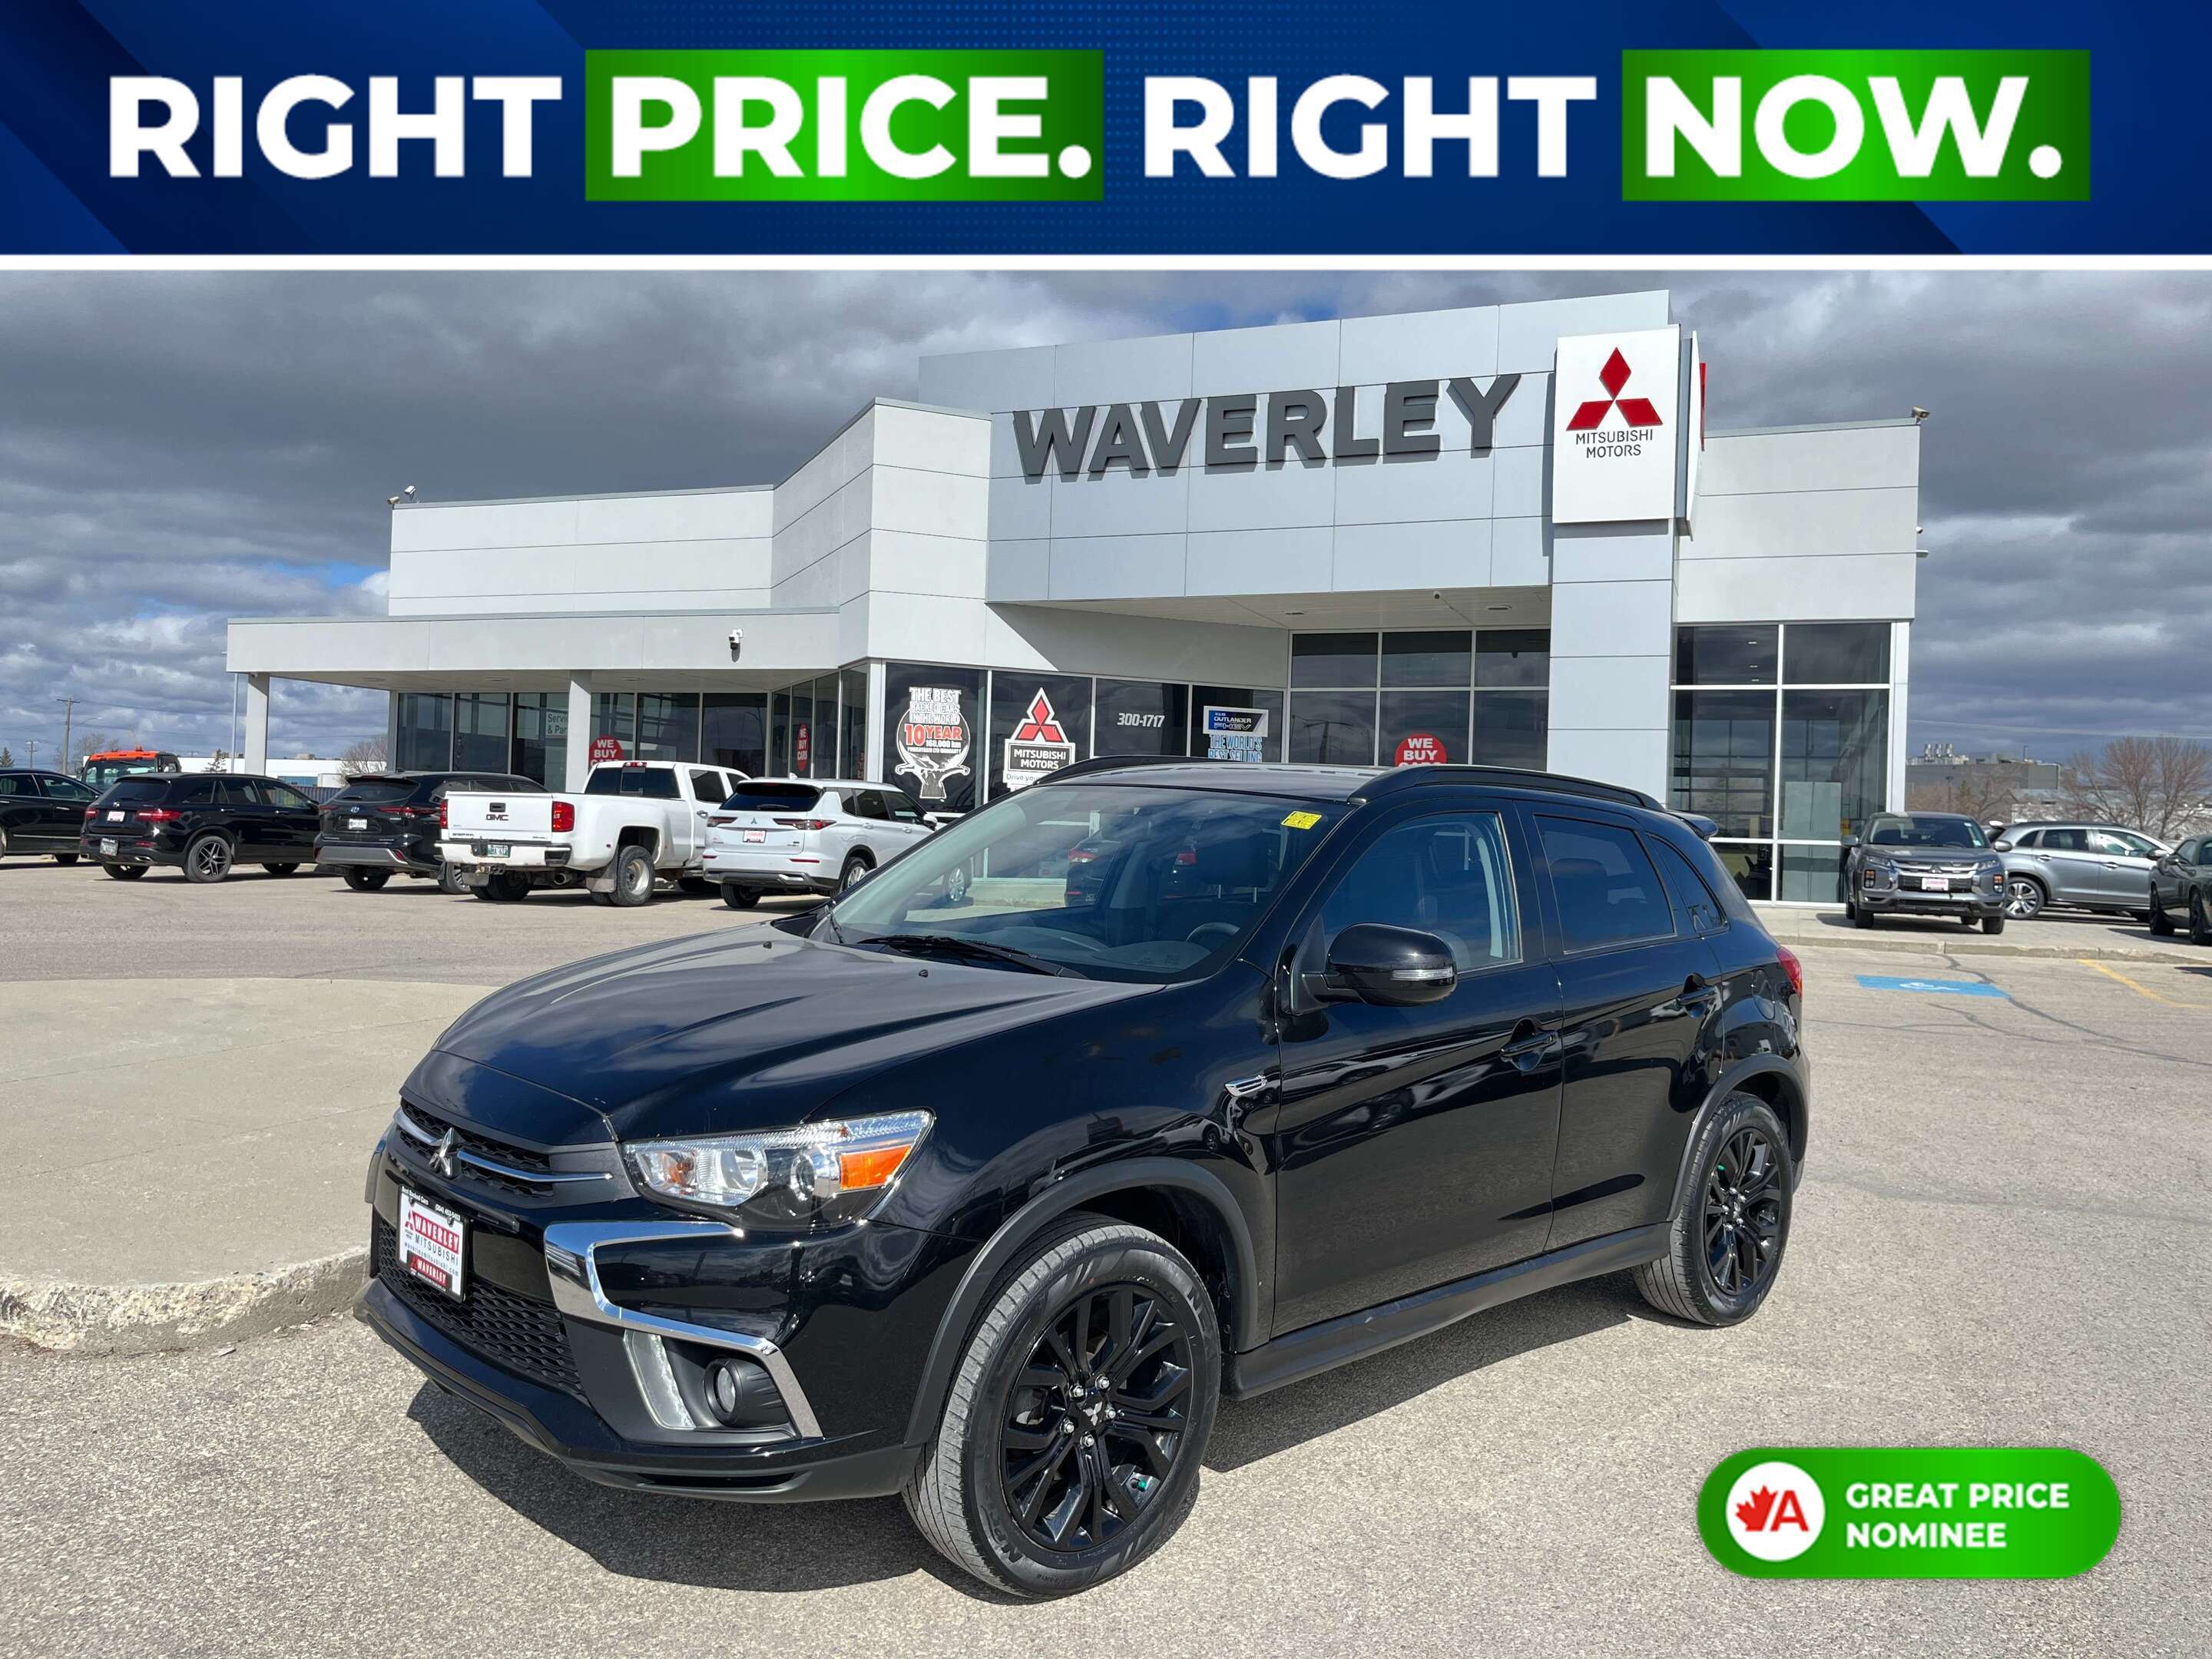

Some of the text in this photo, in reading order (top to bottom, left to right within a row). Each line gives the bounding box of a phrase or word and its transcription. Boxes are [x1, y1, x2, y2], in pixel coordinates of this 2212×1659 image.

[1013, 374, 1522, 476] WAVERLEY
[1575, 429, 1653, 445] MITSUBISHI
[1586, 444, 1641, 459] MOTORS
[909, 687, 962, 704] THE BEST
[941, 703, 960, 714] CARS
[934, 714, 960, 725] WORLD
[1117, 713, 1165, 727] 300-1717
[905, 724, 962, 747] 10 YEAR
[1210, 734, 1226, 749] THE
[597, 740, 614, 748] WE
[1407, 737, 1433, 749] WE
[594, 750, 618, 758] BUY
[1014, 749, 1066, 760] MITSUBISHI
[1403, 750, 1439, 761] BUY
[1021, 759, 1059, 769] MOTORS
[415, 1214, 459, 1253] WAVERLEY
[415, 1234, 459, 1267] MITSUBISHI
[417, 1258, 446, 1283] WAVERLEY
